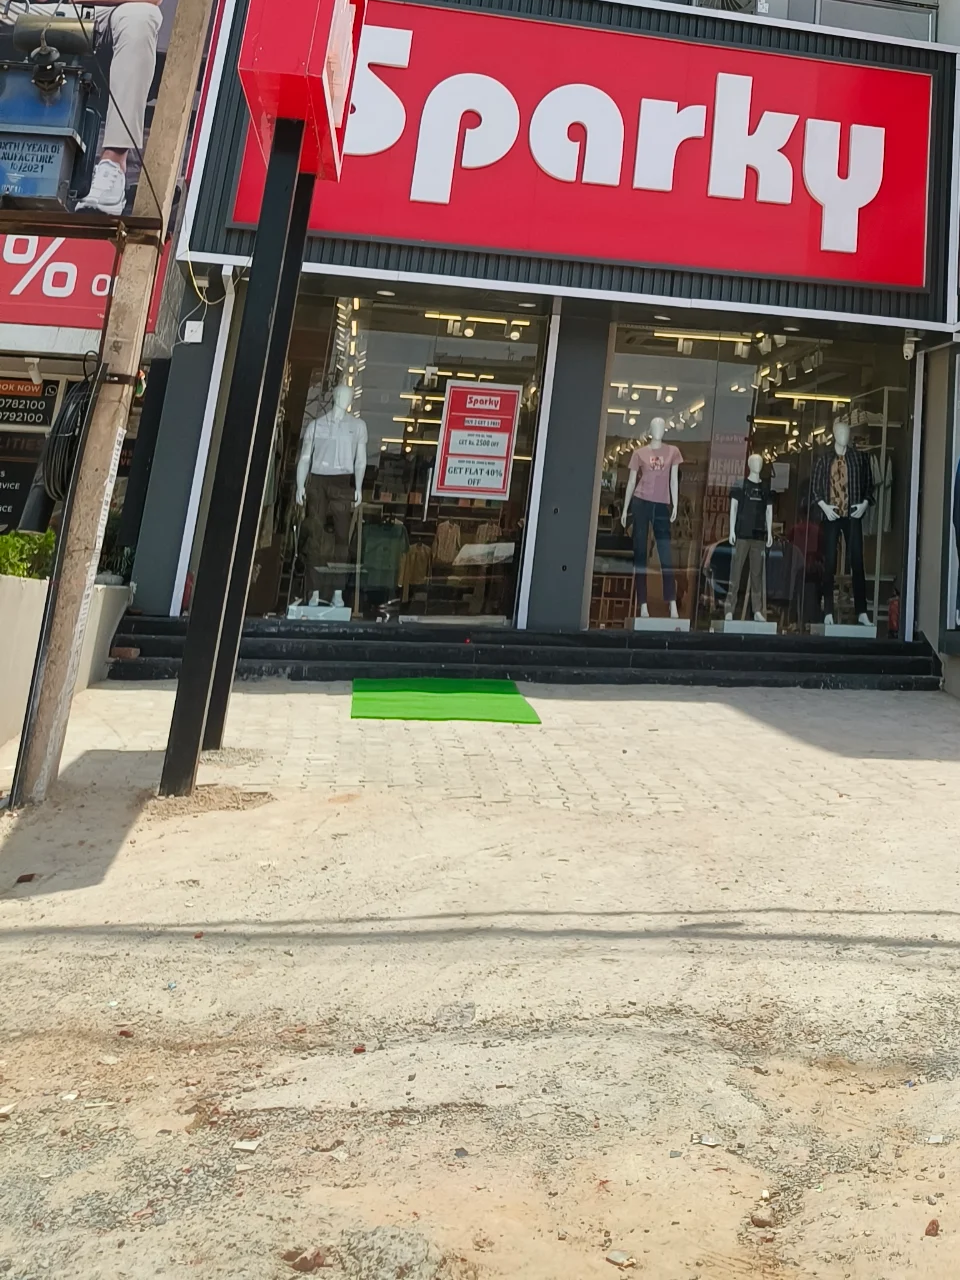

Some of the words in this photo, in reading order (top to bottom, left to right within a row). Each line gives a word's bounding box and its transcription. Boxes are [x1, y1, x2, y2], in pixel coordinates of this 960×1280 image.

[343, 25, 886, 253] Sparky
[17, 385, 40, 393] NOW
[468, 396, 499, 408] Sparky
[448, 466, 463, 475] GET
[464, 467, 484, 476] FLAT
[485, 468, 502, 477] 40%
